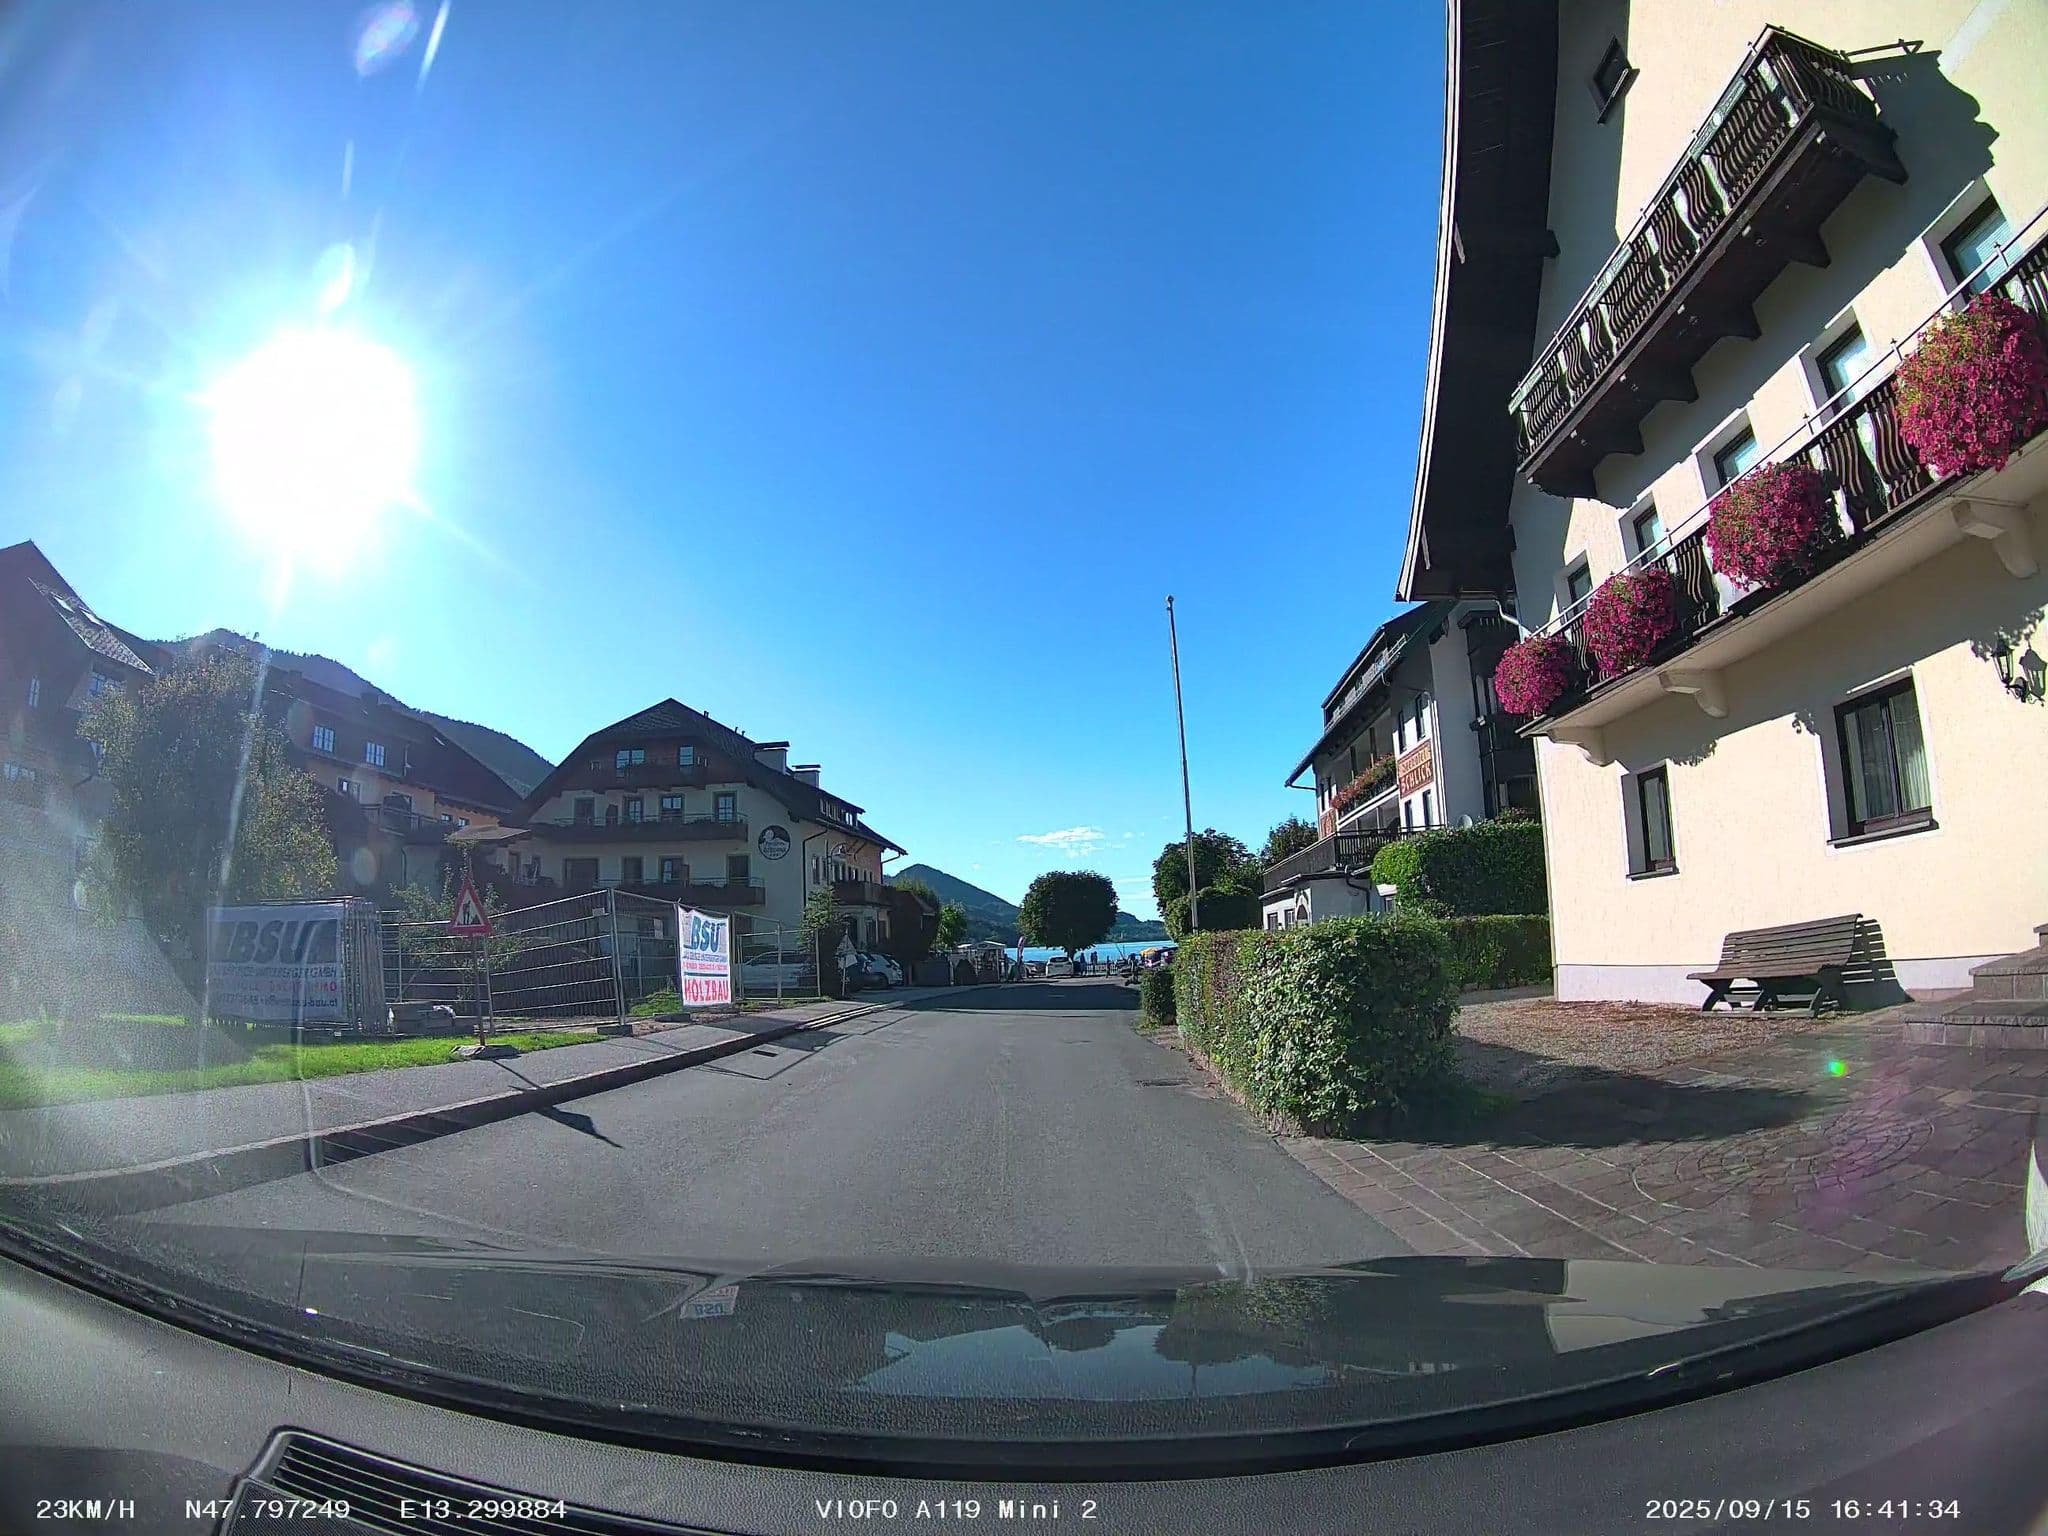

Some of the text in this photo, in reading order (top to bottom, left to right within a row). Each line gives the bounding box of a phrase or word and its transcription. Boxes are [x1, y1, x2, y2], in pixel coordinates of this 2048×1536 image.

[1401, 759, 1432, 793] SCHLICK
[226, 920, 319, 962] BSU
[691, 915, 725, 953] BSU
[684, 979, 729, 1002] HOLZBAU
